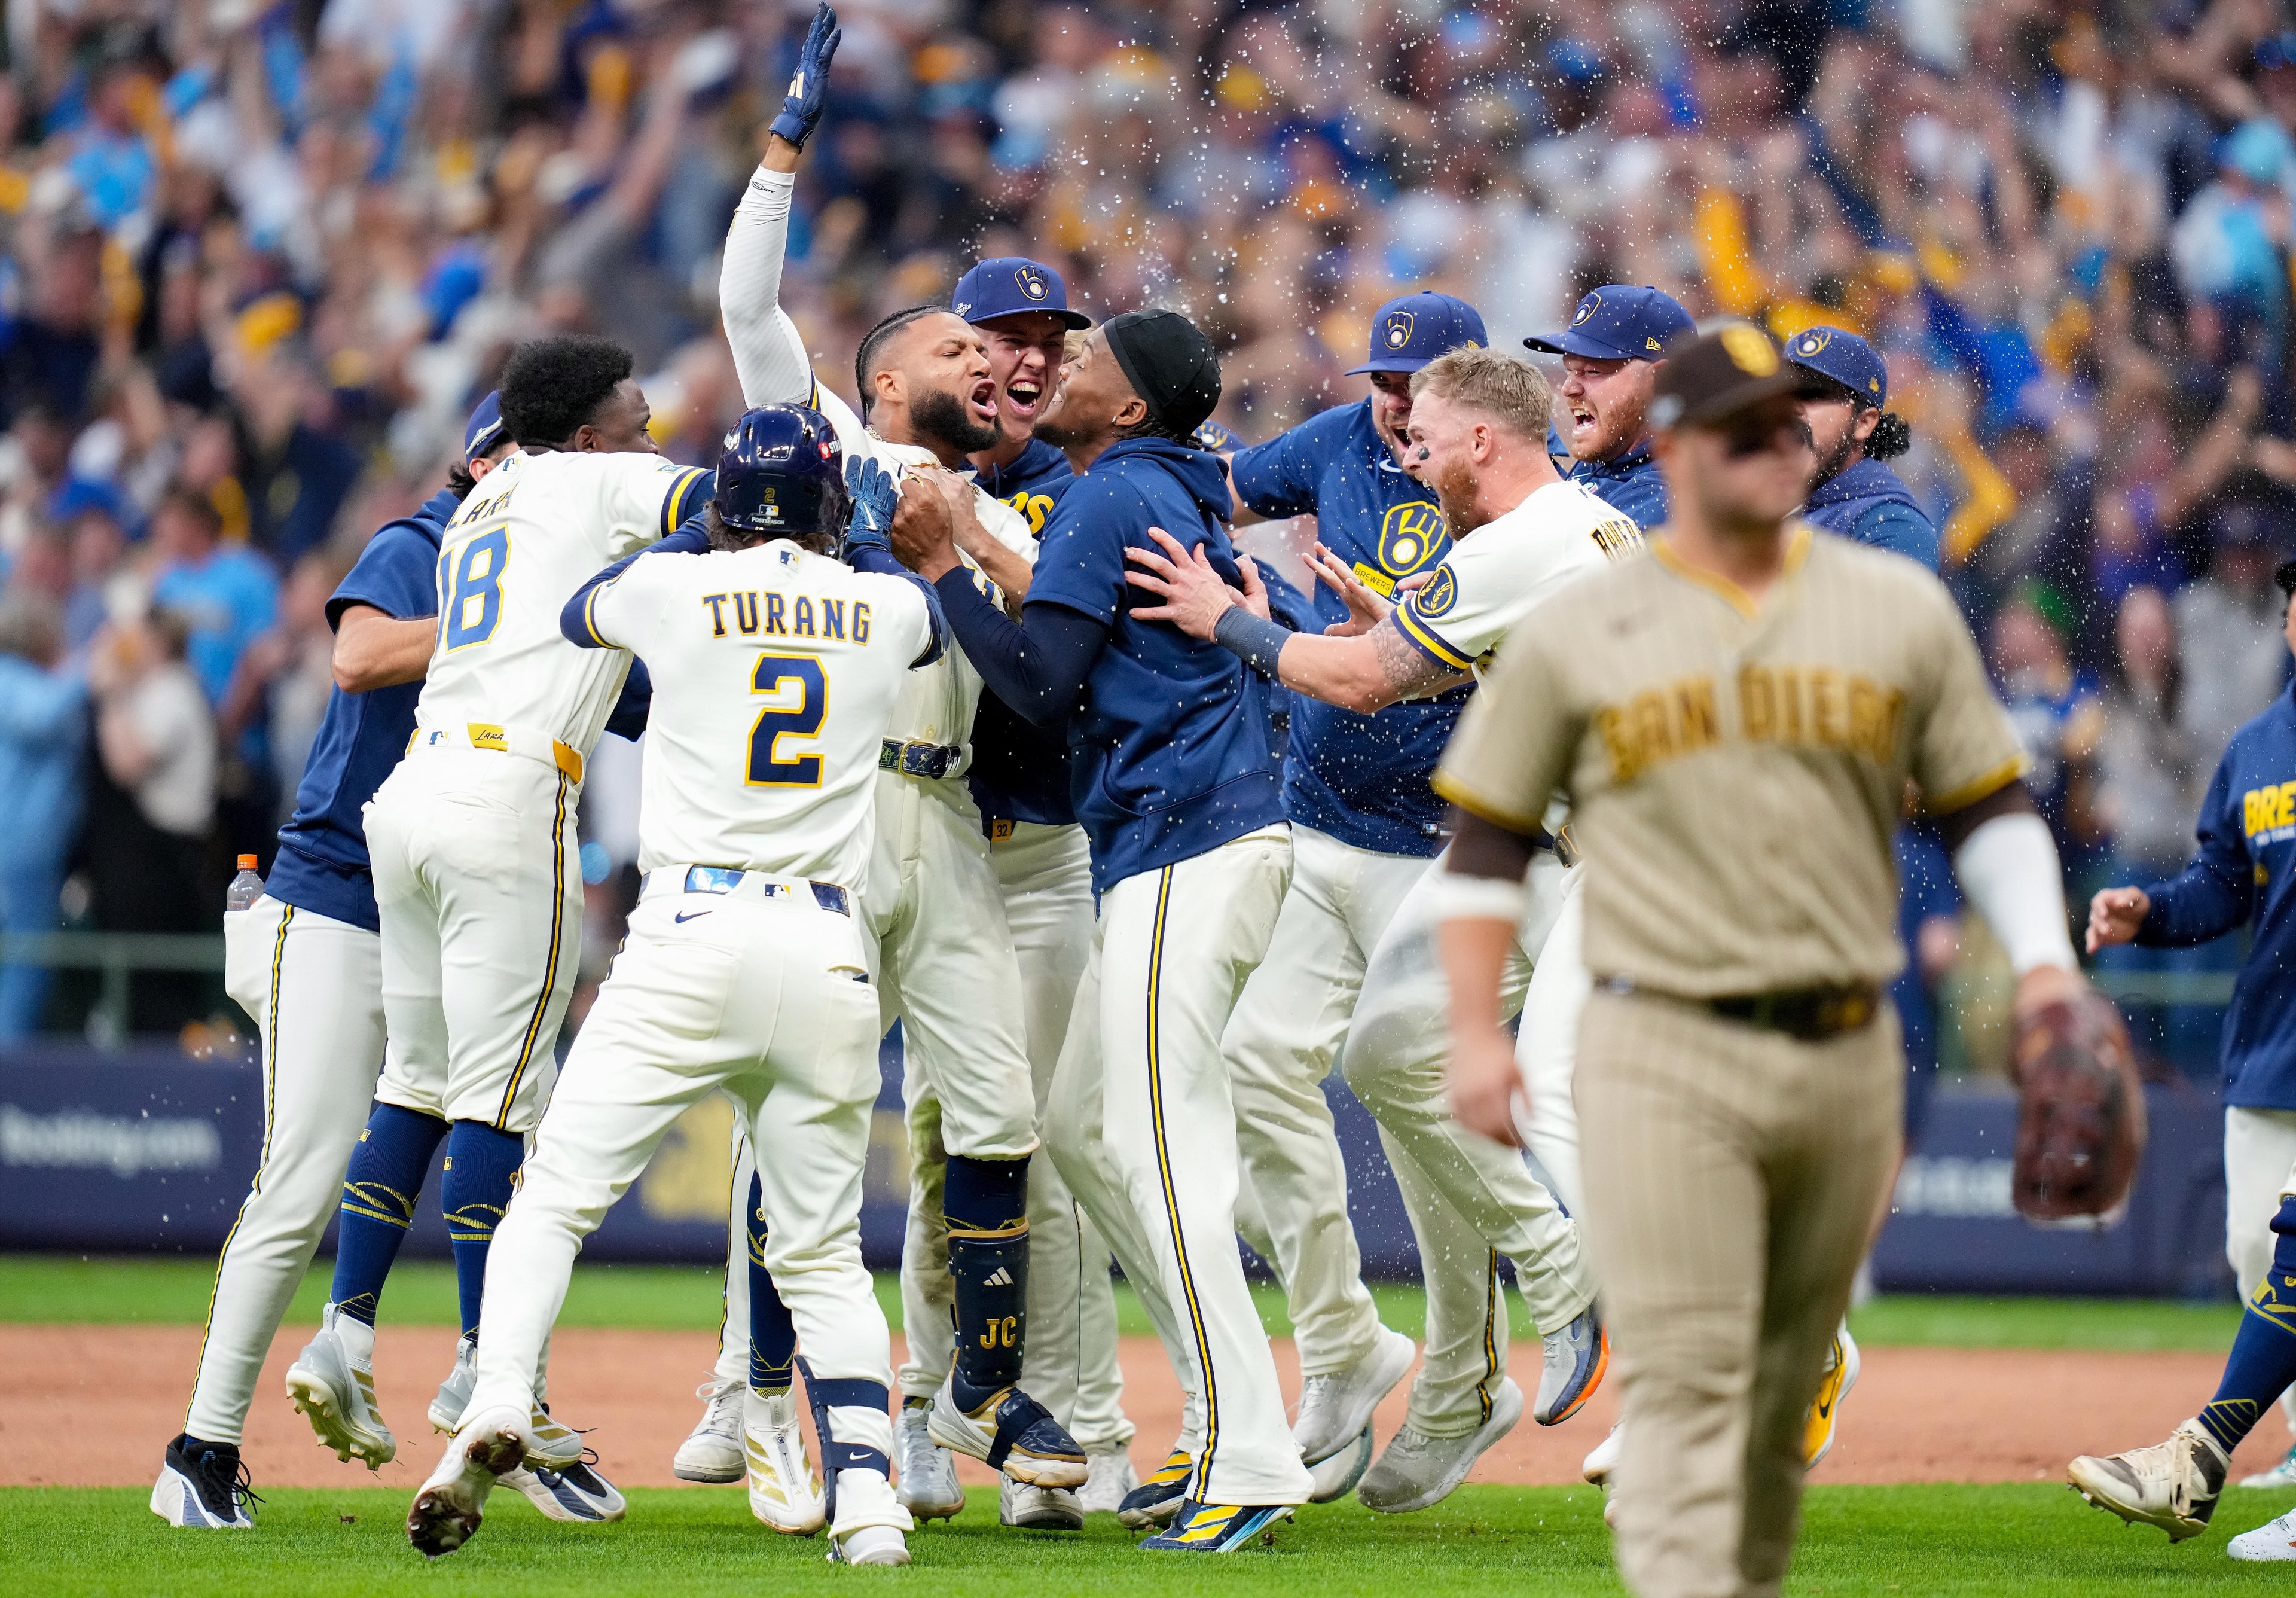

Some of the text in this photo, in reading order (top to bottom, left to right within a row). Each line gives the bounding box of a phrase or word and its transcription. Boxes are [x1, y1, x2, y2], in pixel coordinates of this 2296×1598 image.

[764, 487, 775, 504] 2
[752, 516, 785, 525] POSTSEASON
[1354, 568, 1391, 591] BREWERS
[432, 523, 511, 664] 18
[701, 590, 872, 646] TURANG
[744, 652, 829, 789] 2
[475, 729, 505, 742] LARA
[996, 824, 1007, 837] 32
[980, 1316, 1016, 1350] JC
